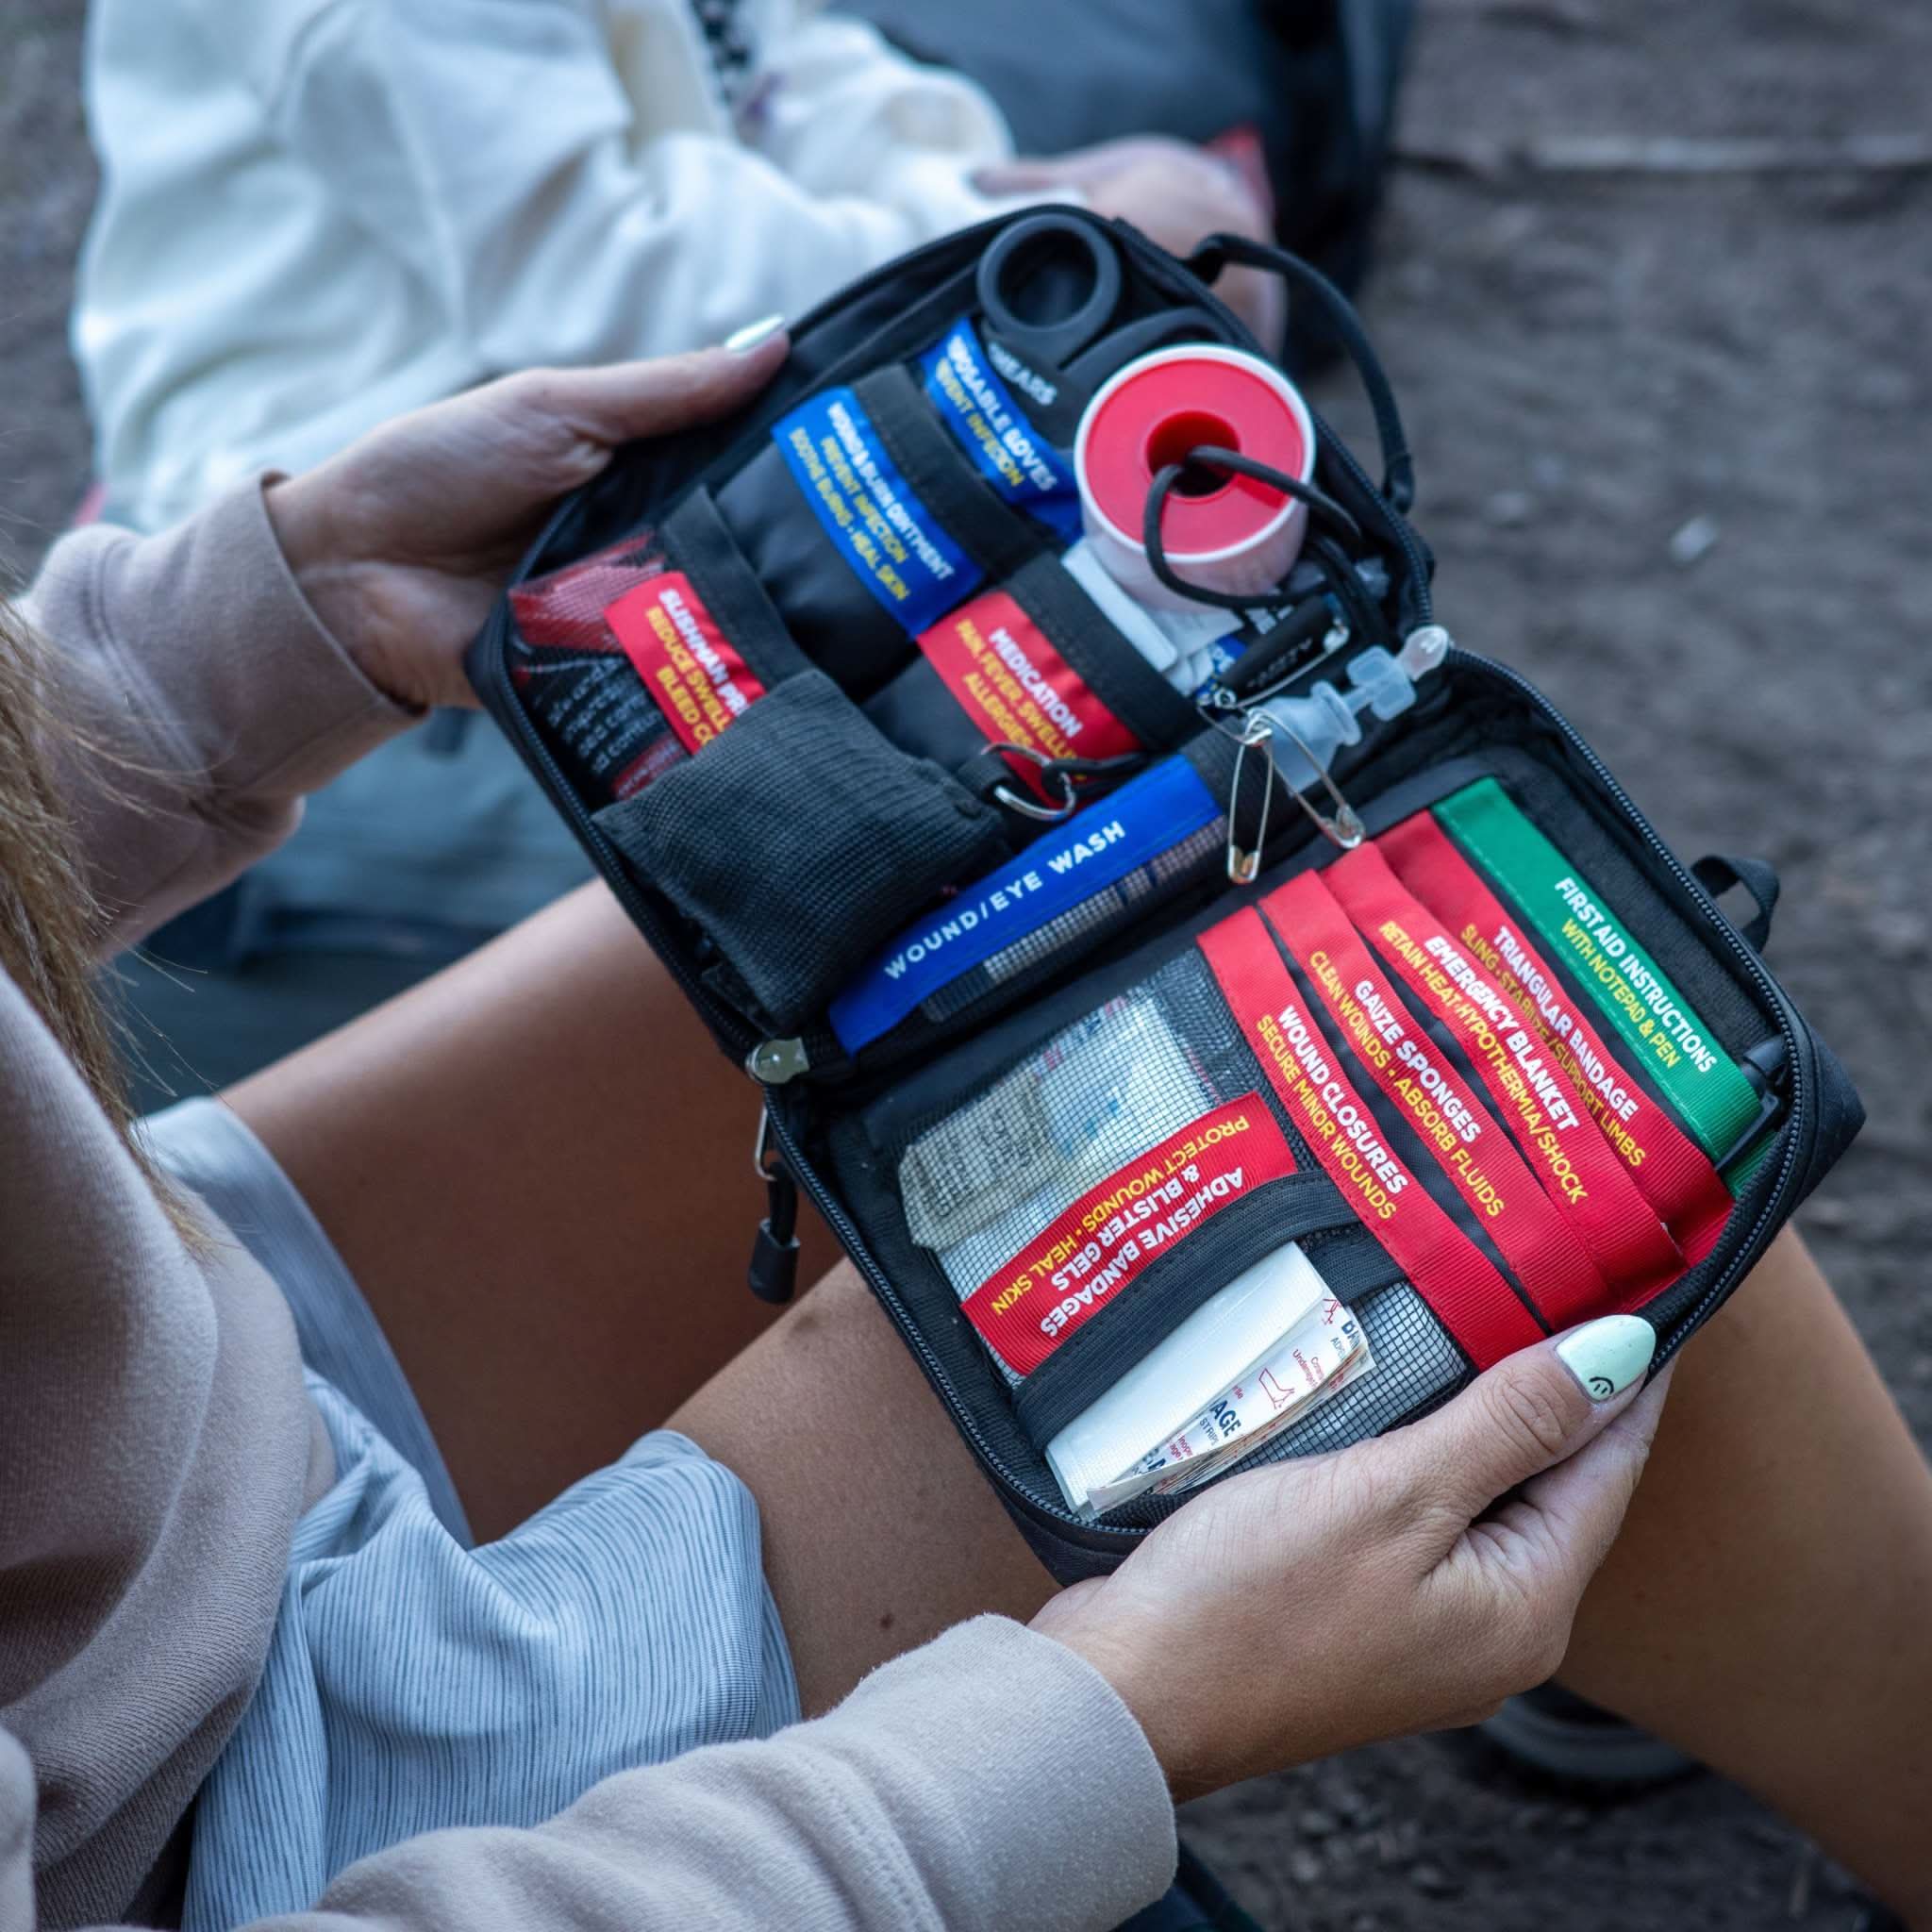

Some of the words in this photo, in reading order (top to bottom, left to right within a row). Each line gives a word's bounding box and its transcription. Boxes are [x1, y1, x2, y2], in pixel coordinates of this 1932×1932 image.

[853, 493, 908, 564] INFECTION
[644, 605, 697, 674] REDUCE
[988, 627, 1082, 738] MEDICATION
[884, 871, 1044, 979] WOUND/EYE
[1047, 821, 1126, 874] WASH
[1493, 925, 1573, 1037] TRIANGULAR
[1569, 1027, 1639, 1122] BANDAGE
[1555, 877, 1605, 929] FIRST
[1592, 924, 1626, 958] AID
[1619, 955, 1717, 1073] INSTRUCTIONS
[1561, 918, 1596, 960] WITH
[1588, 954, 1646, 1024] NOTEPAD
[1638, 1018, 1656, 1039] &
[1648, 1031, 1681, 1068] PEN
[1310, 951, 1344, 1001] CLEAN
[1339, 993, 1391, 1069] WOUNDS
[1393, 1077, 1457, 1152] ABSORB
[1450, 1147, 1505, 1217] FLUIDS
[1355, 979, 1405, 1045] GAUZE
[1395, 1041, 1482, 1143] SPONGES
[1379, 921, 1428, 969] RETAIN
[1419, 963, 1463, 1008] HEAT
[1453, 1002, 1588, 1205] HYPOTHERMIA/SHOCK
[1424, 935, 1520, 1030] EMERGENCY
[1506, 1029, 1579, 1130] BLANKET
[1460, 924, 1500, 971] SLING
[1600, 1110, 1646, 1166] LIMBS
[1159, 1115, 1250, 1178] PROTECT
[1257, 1014, 1302, 1084] SECURE
[1292, 1078, 1337, 1141] MINOR
[1330, 1134, 1397, 1219] WOUNDS
[1278, 1005, 1330, 1085] WOUND
[1322, 1081, 1408, 1194] CLOSURES
[1082, 1167, 1165, 1232] WOUNDS
[1096, 1176, 1184, 1247] BLISTER
[1137, 1166, 1242, 1250] ADHESIVE
[1180, 1163, 1200, 1183] &
[991, 1274, 1033, 1315] SKIN
[1028, 1235, 1077, 1277] HEAL
[1041, 1239, 1141, 1337] BANDAGES
[1051, 1241, 1102, 1291] GELS
[1209, 1400, 1241, 1438] AGE
